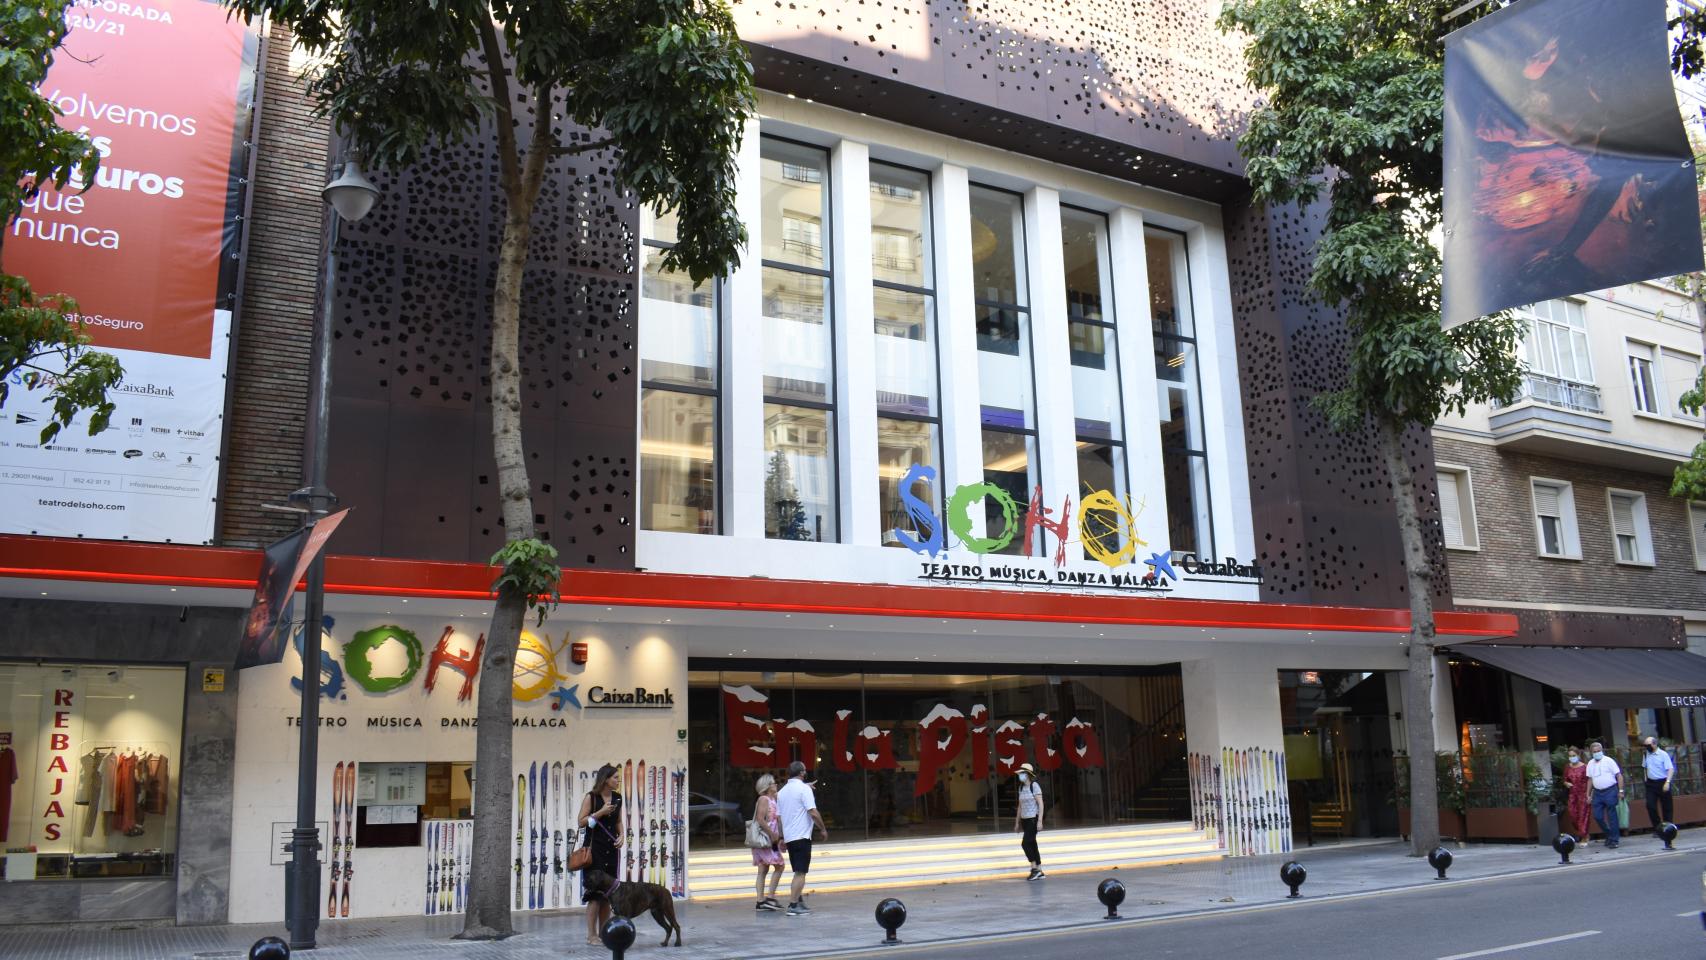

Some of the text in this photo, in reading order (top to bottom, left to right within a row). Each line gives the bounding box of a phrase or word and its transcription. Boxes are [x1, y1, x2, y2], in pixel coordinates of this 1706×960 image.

[14, 217, 119, 249] nunca
[183, 429, 205, 437] vithas
[38, 498, 126, 511] teatrodelsoho.com
[895, 463, 1148, 567] SOHO
[920, 562, 1169, 588] TEATRO MÚSICA DANZA MÁLAGA
[1181, 553, 1264, 578] CaixaBank
[587, 685, 674, 705] CaixaBank
[286, 715, 567, 728] TETRO MÚSICA DANZ MÁLAGA
[722, 684, 817, 770] En
[833, 709, 898, 772] la
[44, 689, 74, 841] REBAJAS
